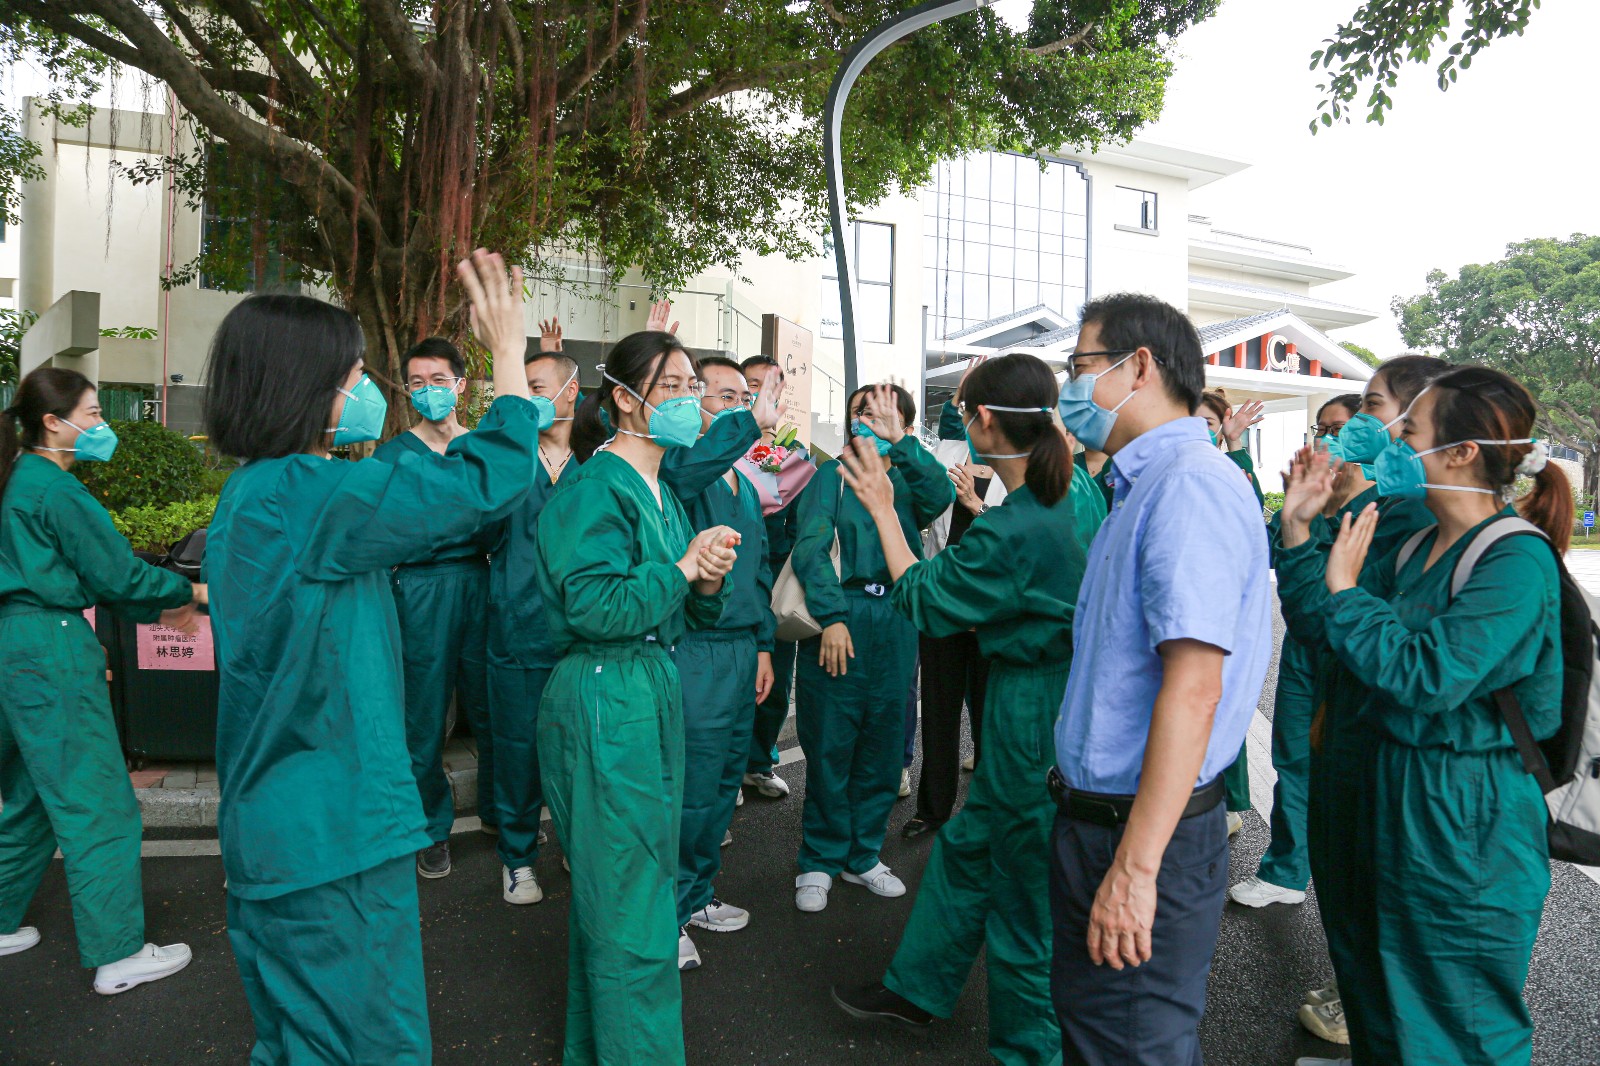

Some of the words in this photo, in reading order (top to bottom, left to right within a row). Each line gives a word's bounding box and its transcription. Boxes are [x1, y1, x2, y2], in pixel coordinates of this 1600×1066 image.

[152, 634, 197, 642] 附属肿瘤医院
[156, 646, 194, 658] 林思婷
